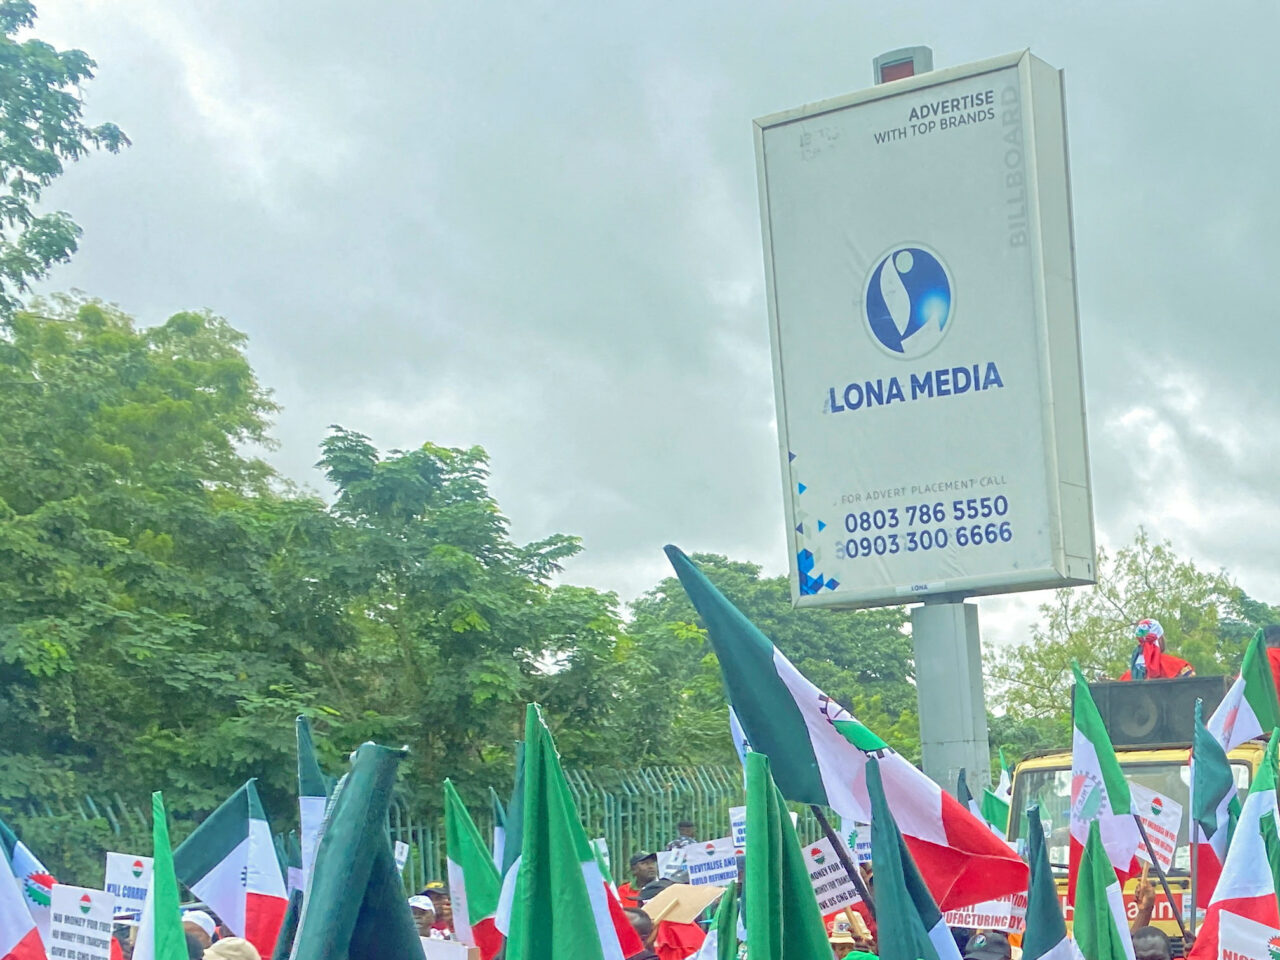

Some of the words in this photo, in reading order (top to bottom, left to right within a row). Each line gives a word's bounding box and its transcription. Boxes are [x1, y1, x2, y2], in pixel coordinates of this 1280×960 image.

[908, 90, 994, 122] ADVERTISE
[874, 128, 907, 144] WITH
[910, 120, 936, 138] TOP
[940, 108, 995, 131] BRANDS
[1001, 86, 1028, 248] BILLBOARD
[829, 377, 906, 413] LONA
[910, 362, 1004, 400] MEDIA
[841, 494, 862, 505] FOR
[866, 488, 906, 502] ADVERT
[911, 480, 976, 496] PLACEMENT
[979, 476, 1008, 487] CALL
[844, 508, 900, 533] 0803
[906, 502, 946, 526] 786
[952, 495, 1008, 520] 5550
[845, 534, 900, 559] 0903
[907, 528, 948, 552] 300
[956, 521, 1012, 547] 6666
[911, 584, 928, 592] LONA
[690, 860, 723, 874] REVITALISE
[724, 857, 736, 866] AND
[945, 912, 1008, 927] UFACTURING
